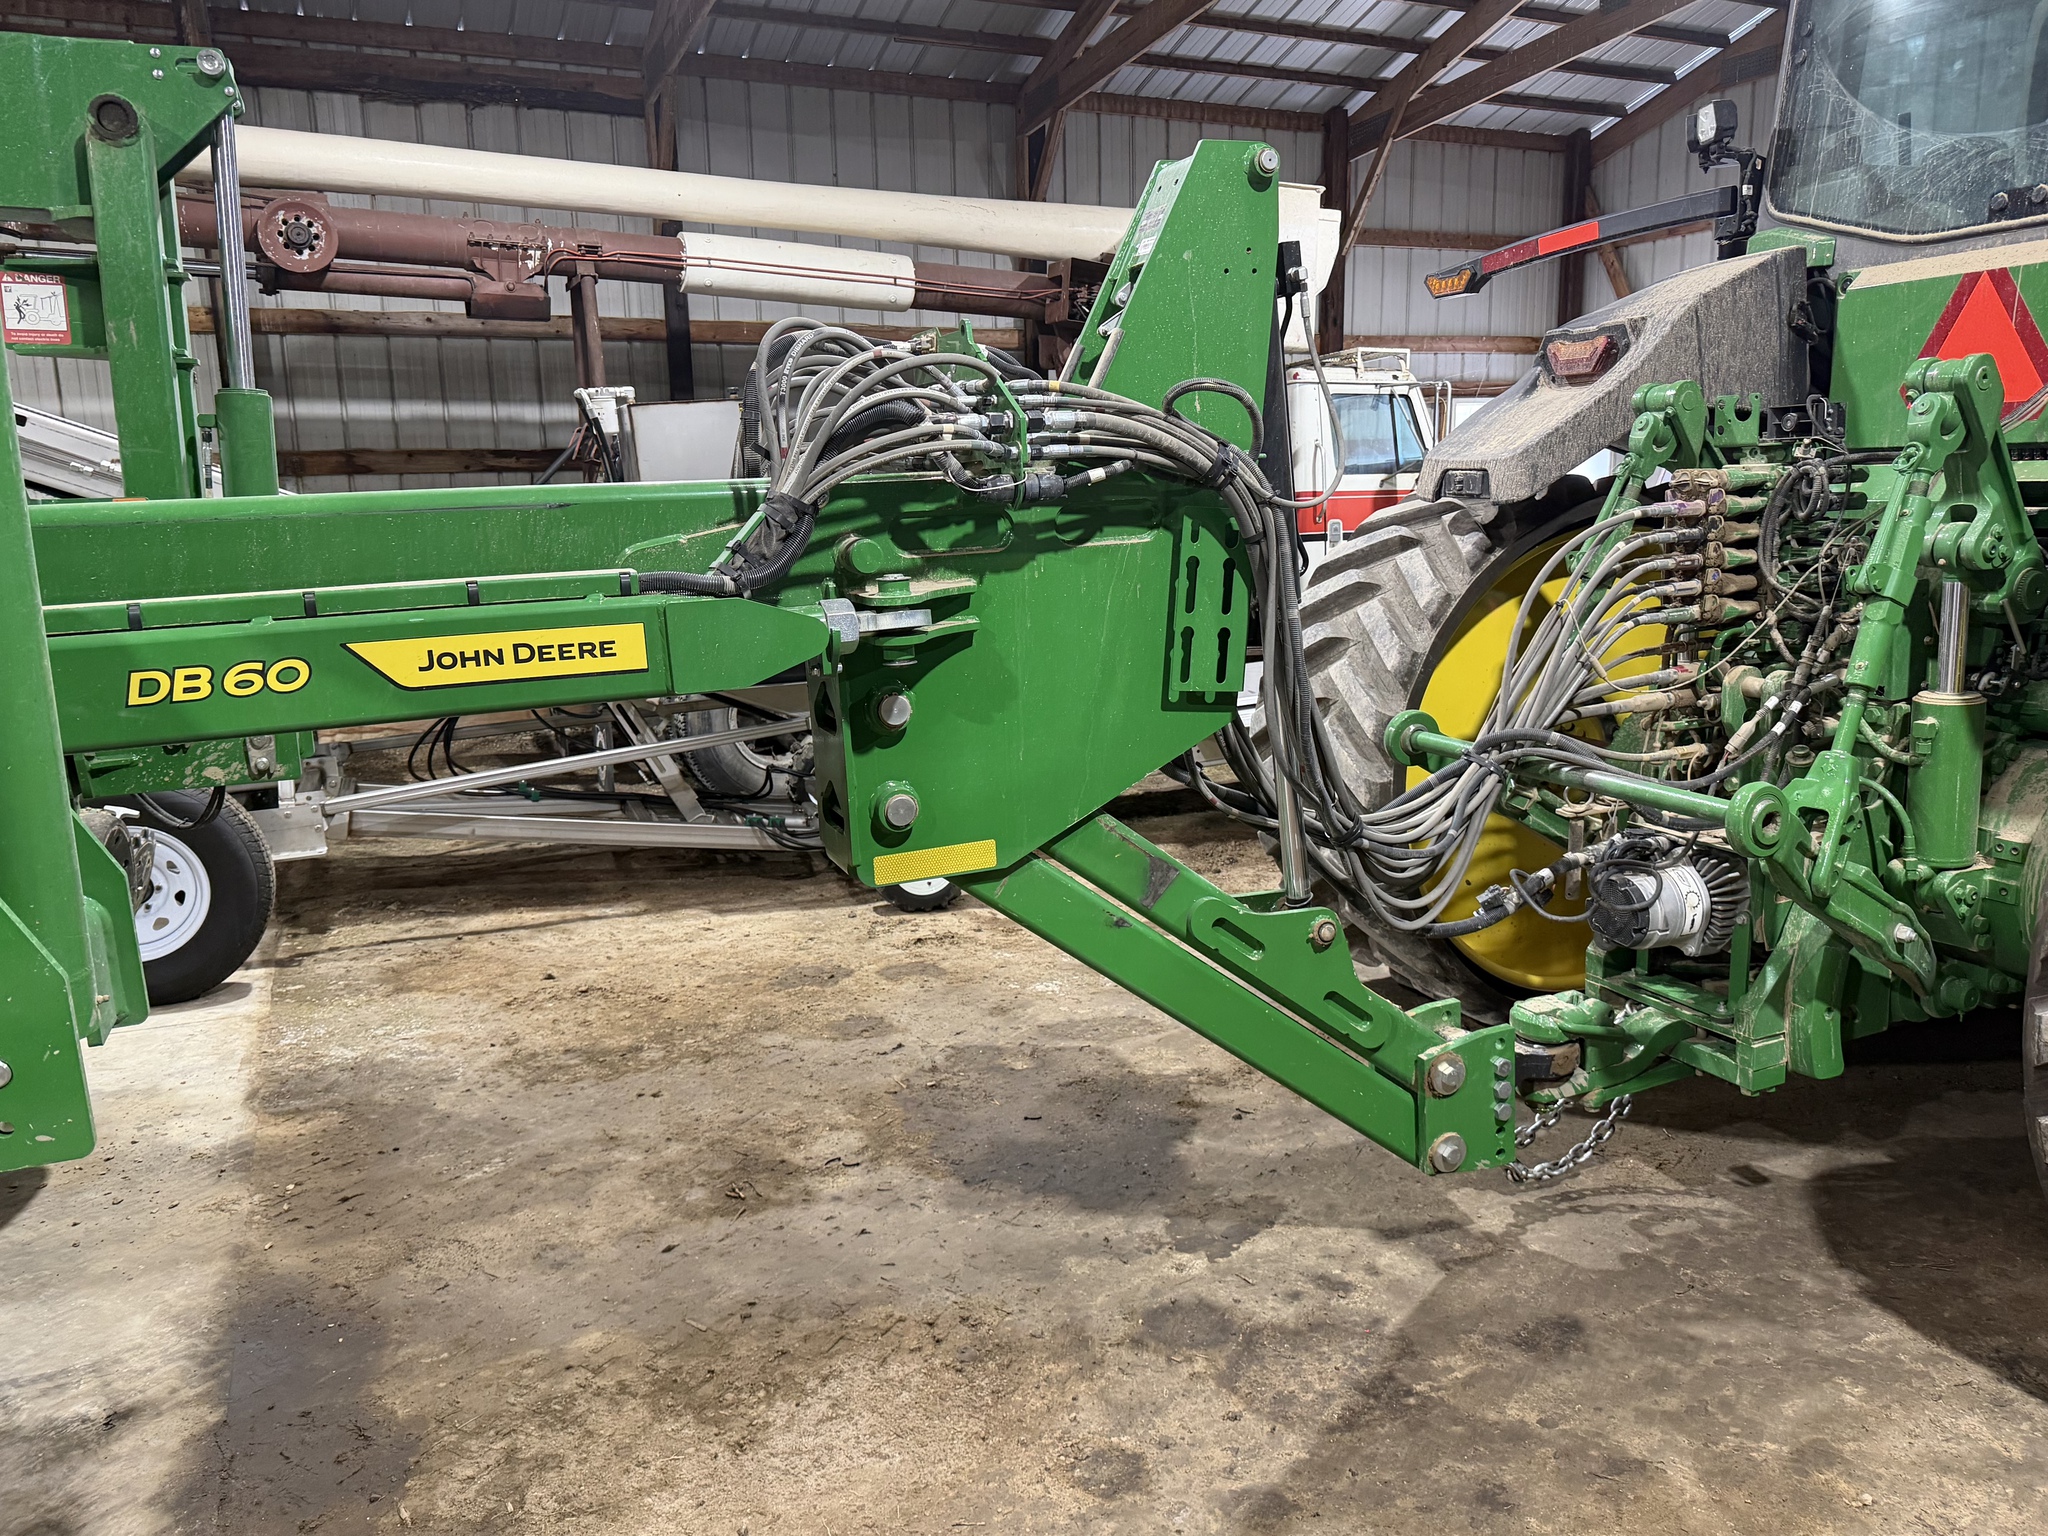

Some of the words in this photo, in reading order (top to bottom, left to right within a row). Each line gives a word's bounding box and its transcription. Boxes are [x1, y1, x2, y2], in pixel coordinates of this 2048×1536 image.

[15, 273, 61, 284] DANGER
[791, 332, 815, 357] DIEHARD
[418, 648, 505, 672] JOHN
[512, 640, 617, 664] DEERE
[125, 664, 215, 709] DB
[221, 656, 312, 698] 60
